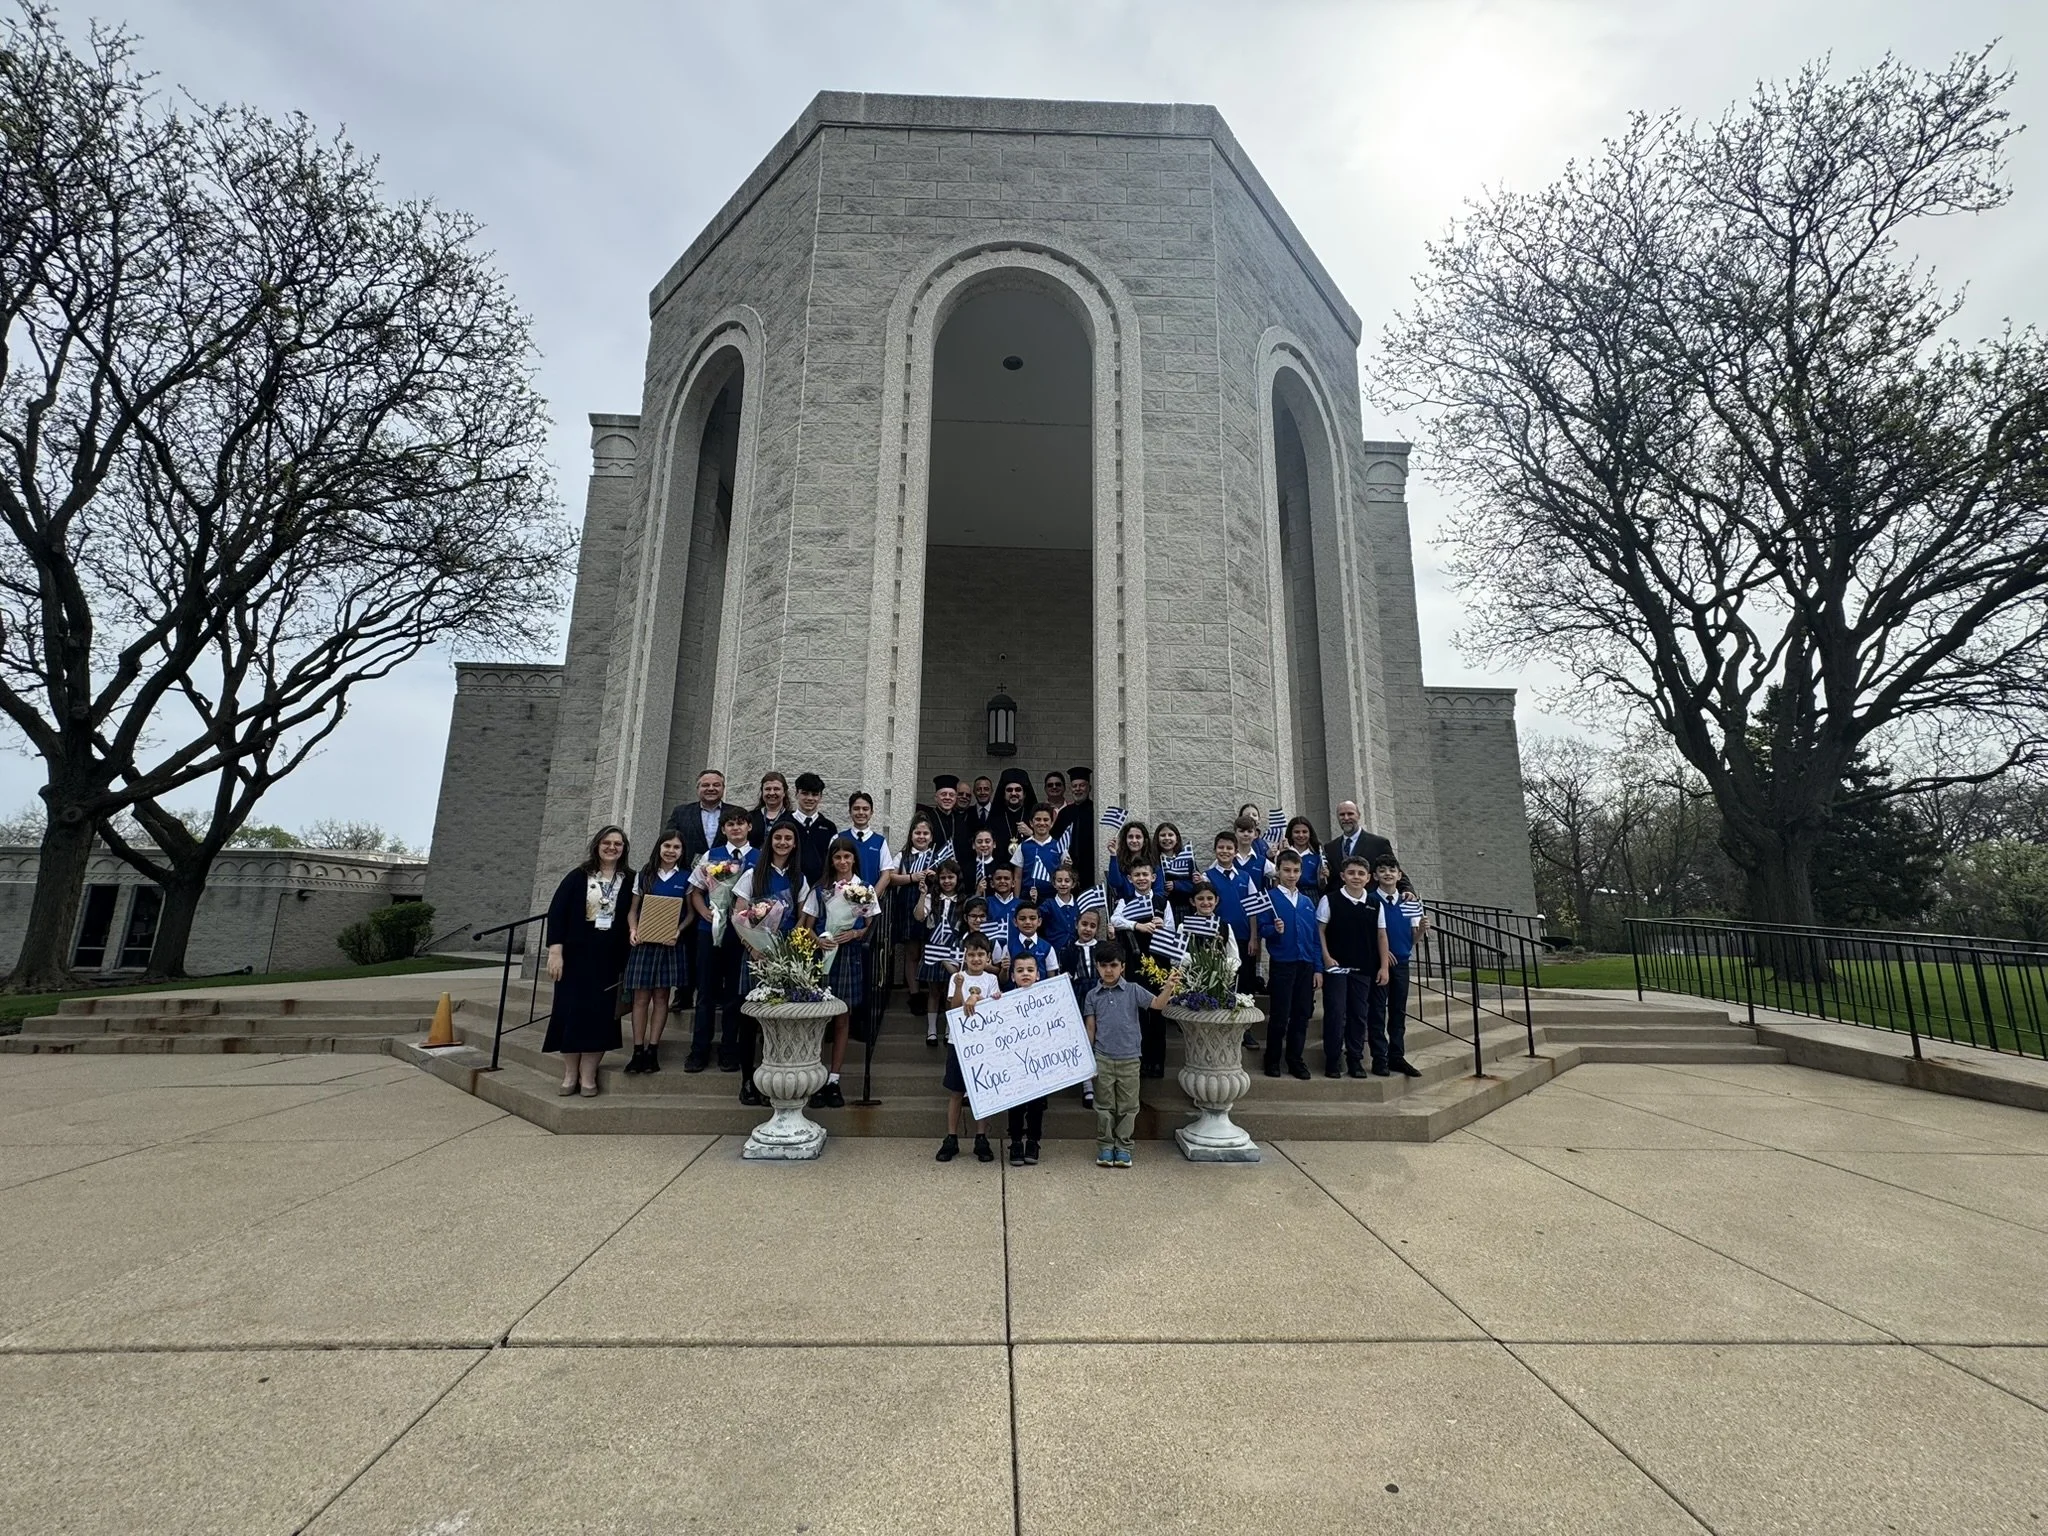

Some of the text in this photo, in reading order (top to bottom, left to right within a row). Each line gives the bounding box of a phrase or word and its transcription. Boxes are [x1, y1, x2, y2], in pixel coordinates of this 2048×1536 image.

[958, 994, 1056, 1033] Καλώς ήρθατε
[963, 1043, 984, 1059] στο
[995, 1023, 1041, 1051] σχολείο
[971, 1040, 1082, 1094] Κύριε Υφυπουργέ
